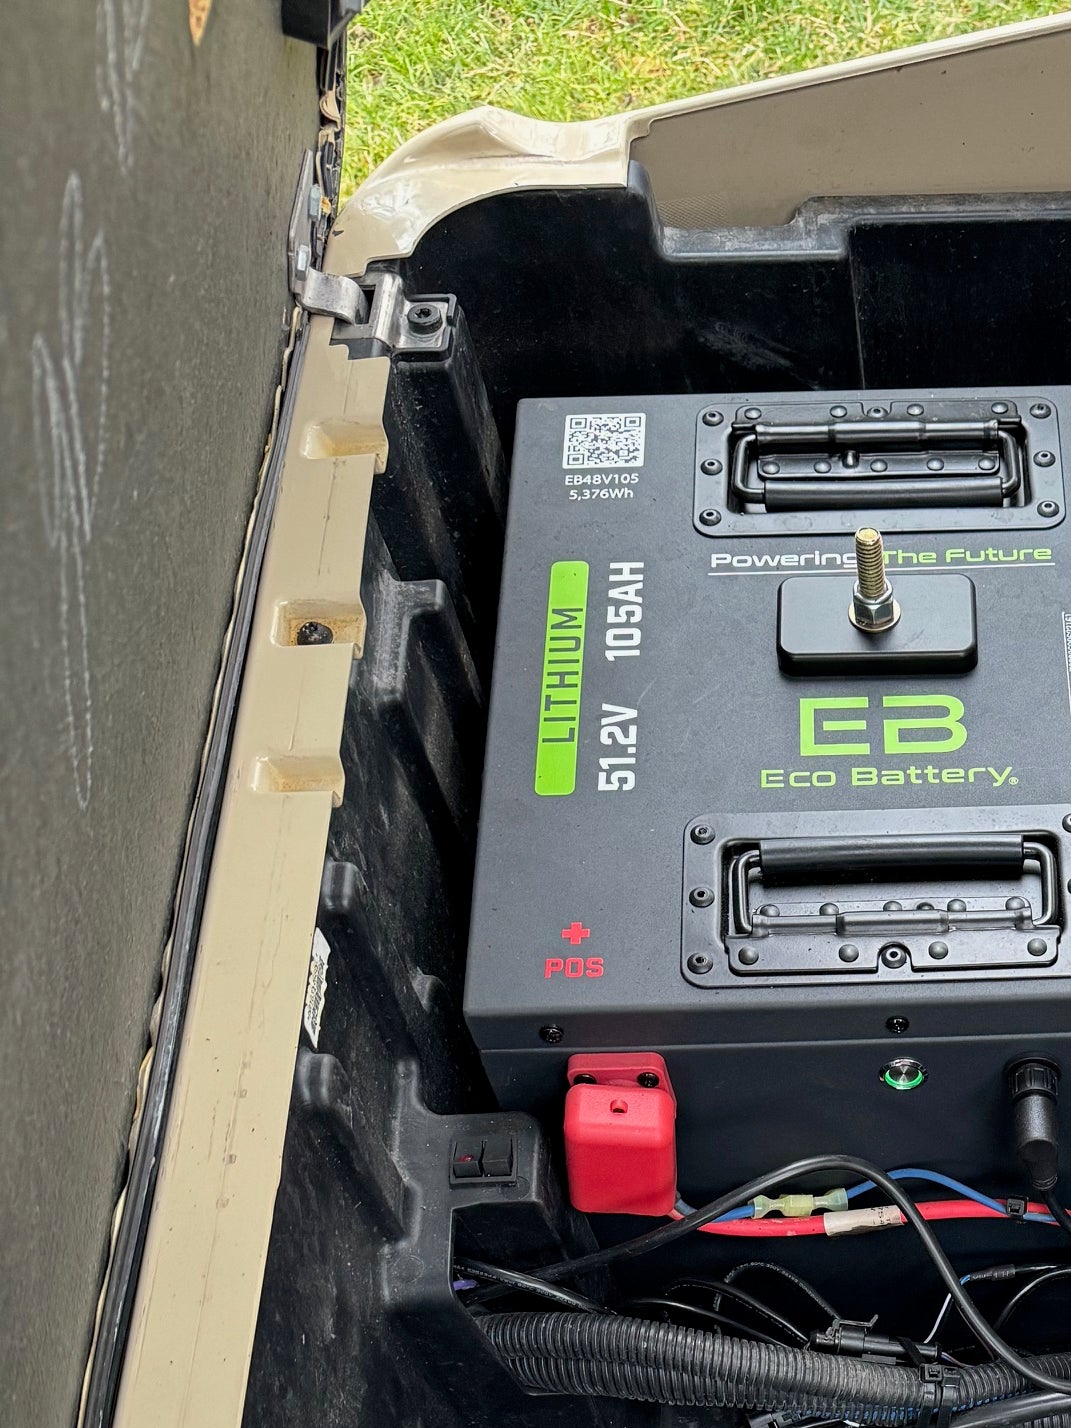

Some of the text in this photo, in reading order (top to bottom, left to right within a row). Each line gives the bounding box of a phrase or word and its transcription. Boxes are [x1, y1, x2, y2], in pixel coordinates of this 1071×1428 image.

[564, 473, 640, 486] EB48V105
[568, 487, 634, 501] 5,376Wh
[710, 547, 1053, 569] Powering The Future
[541, 607, 584, 743] LITHIUM
[597, 561, 645, 792] 51.2V 105AH
[799, 694, 968, 757] EB
[760, 768, 837, 788] Eco
[543, 956, 605, 979] POS
